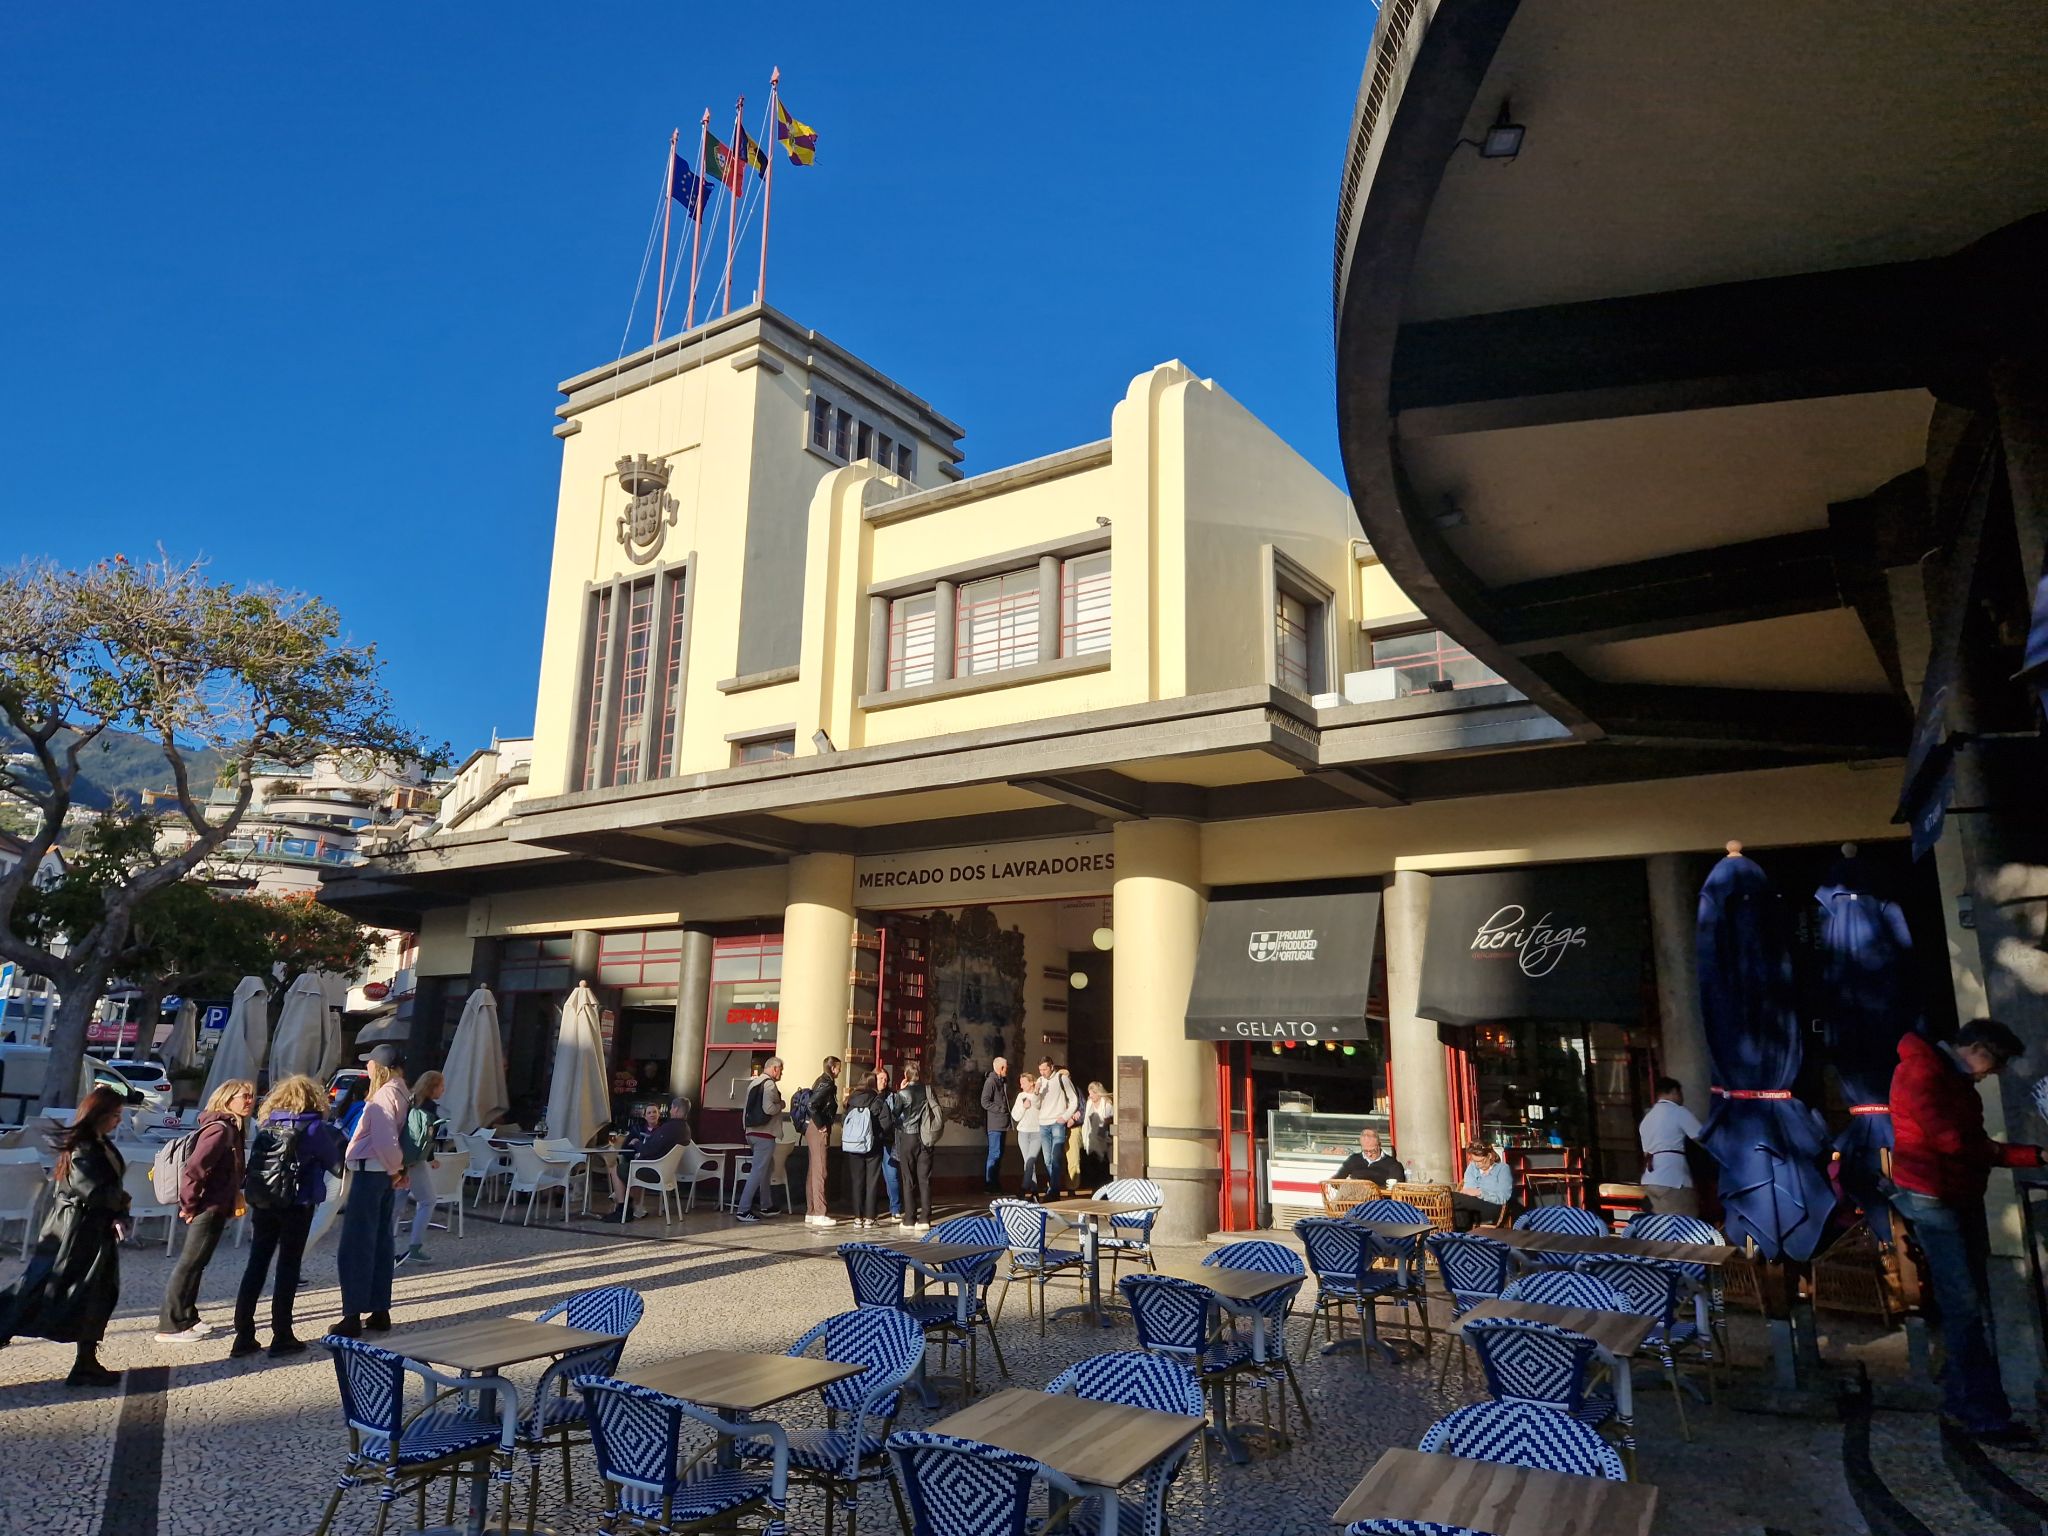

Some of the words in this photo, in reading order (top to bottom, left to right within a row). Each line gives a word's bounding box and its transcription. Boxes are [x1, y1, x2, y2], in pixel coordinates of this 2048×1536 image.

[859, 868, 944, 888] MERCADO
[950, 864, 986, 882] DOS
[992, 853, 1114, 879] LAVRADORES
[1279, 929, 1314, 941] PROUDLY
[1470, 904, 1586, 977] heritage
[1277, 939, 1318, 951] PRODUCED
[1275, 950, 1315, 961] PORTUGAL
[209, 1008, 223, 1027] P
[1236, 1021, 1317, 1037] GELATO
